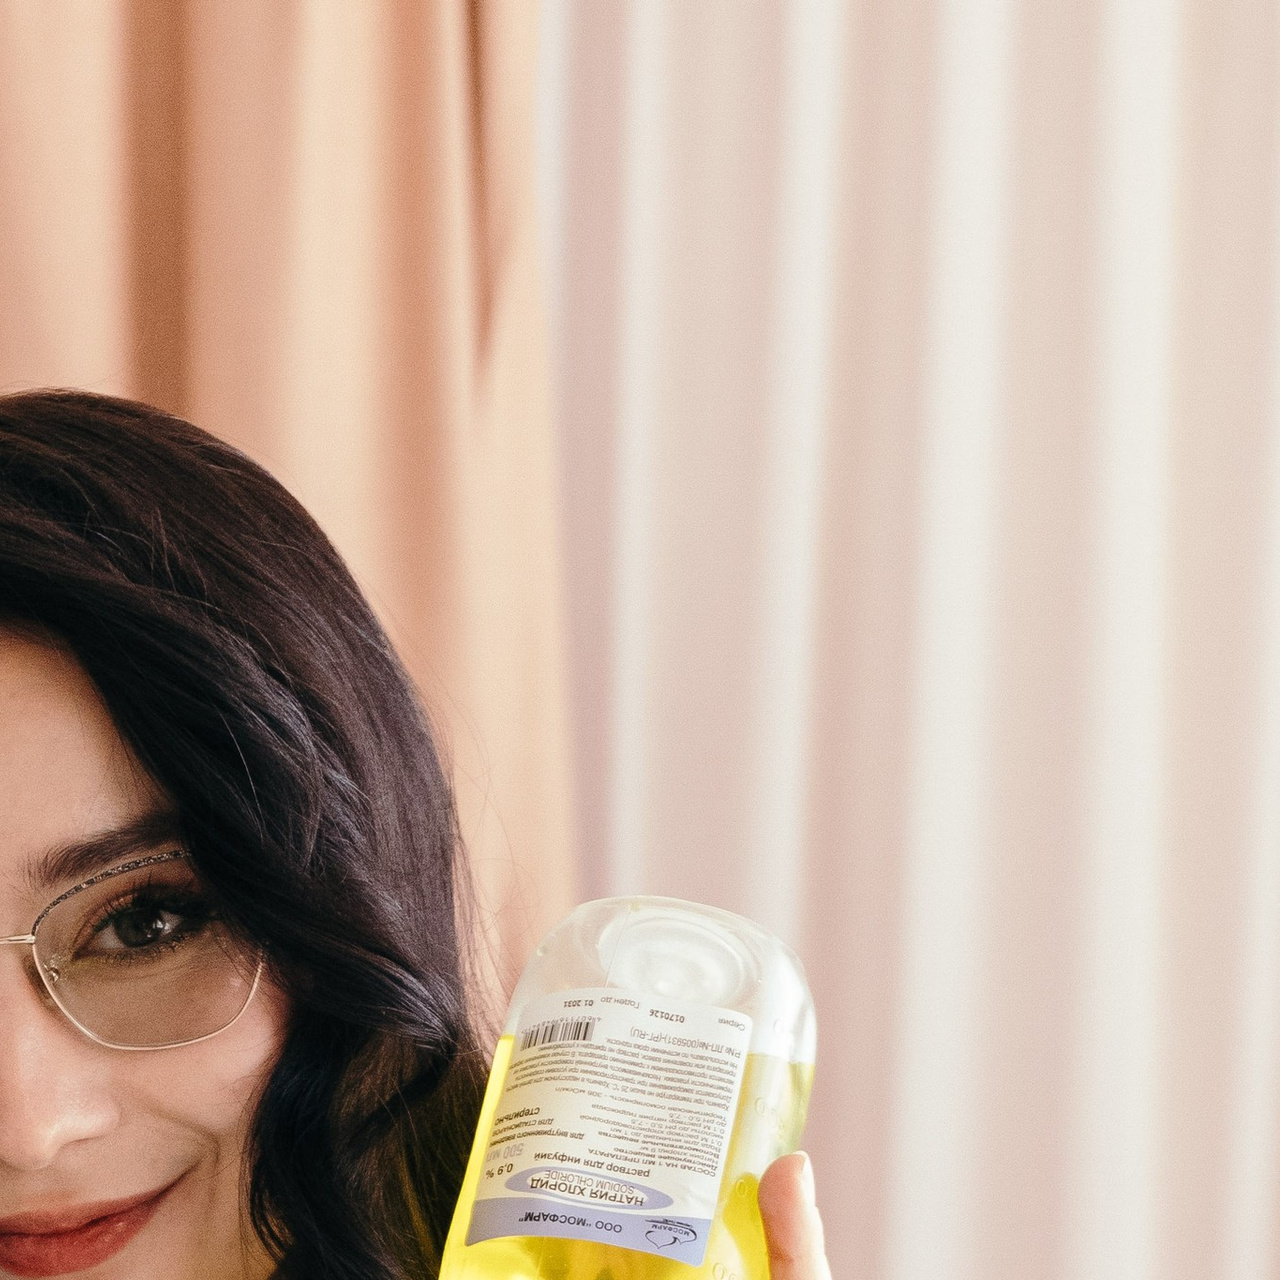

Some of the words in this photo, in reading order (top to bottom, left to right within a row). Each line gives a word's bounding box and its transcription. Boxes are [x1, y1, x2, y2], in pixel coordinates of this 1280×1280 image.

[563, 999, 581, 1007] 2031
[600, 995, 612, 1003] до
[613, 997, 639, 1009] Годен
[649, 1008, 684, 1023] 0170126
[717, 1017, 745, 1031] Серия
[494, 1106, 539, 1126] стерильно
[597, 1130, 638, 1143] вещества
[503, 1142, 523, 1160] 500
[587, 1148, 639, 1163] ПРЕПАРАТА
[613, 1147, 655, 1158] вещество
[641, 1139, 719, 1158] Вспомогательные
[533, 1151, 580, 1166] инфузий
[583, 1158, 603, 1169] для
[657, 1154, 717, 1171] Действующее
[485, 1169, 494, 1179] %
[497, 1162, 513, 1175] 0,9
[605, 1162, 650, 1178] раствор
[680, 1163, 715, 1177] СОСТАВ
[543, 1169, 593, 1186] CHLORIDE
[529, 1178, 586, 1195] ХЛОРИД
[596, 1179, 634, 1194] SODIUM
[589, 1188, 643, 1205] НАТРИЯ
[595, 1220, 622, 1233] ООО
[651, 1223, 689, 1236] МОСФАРМ
